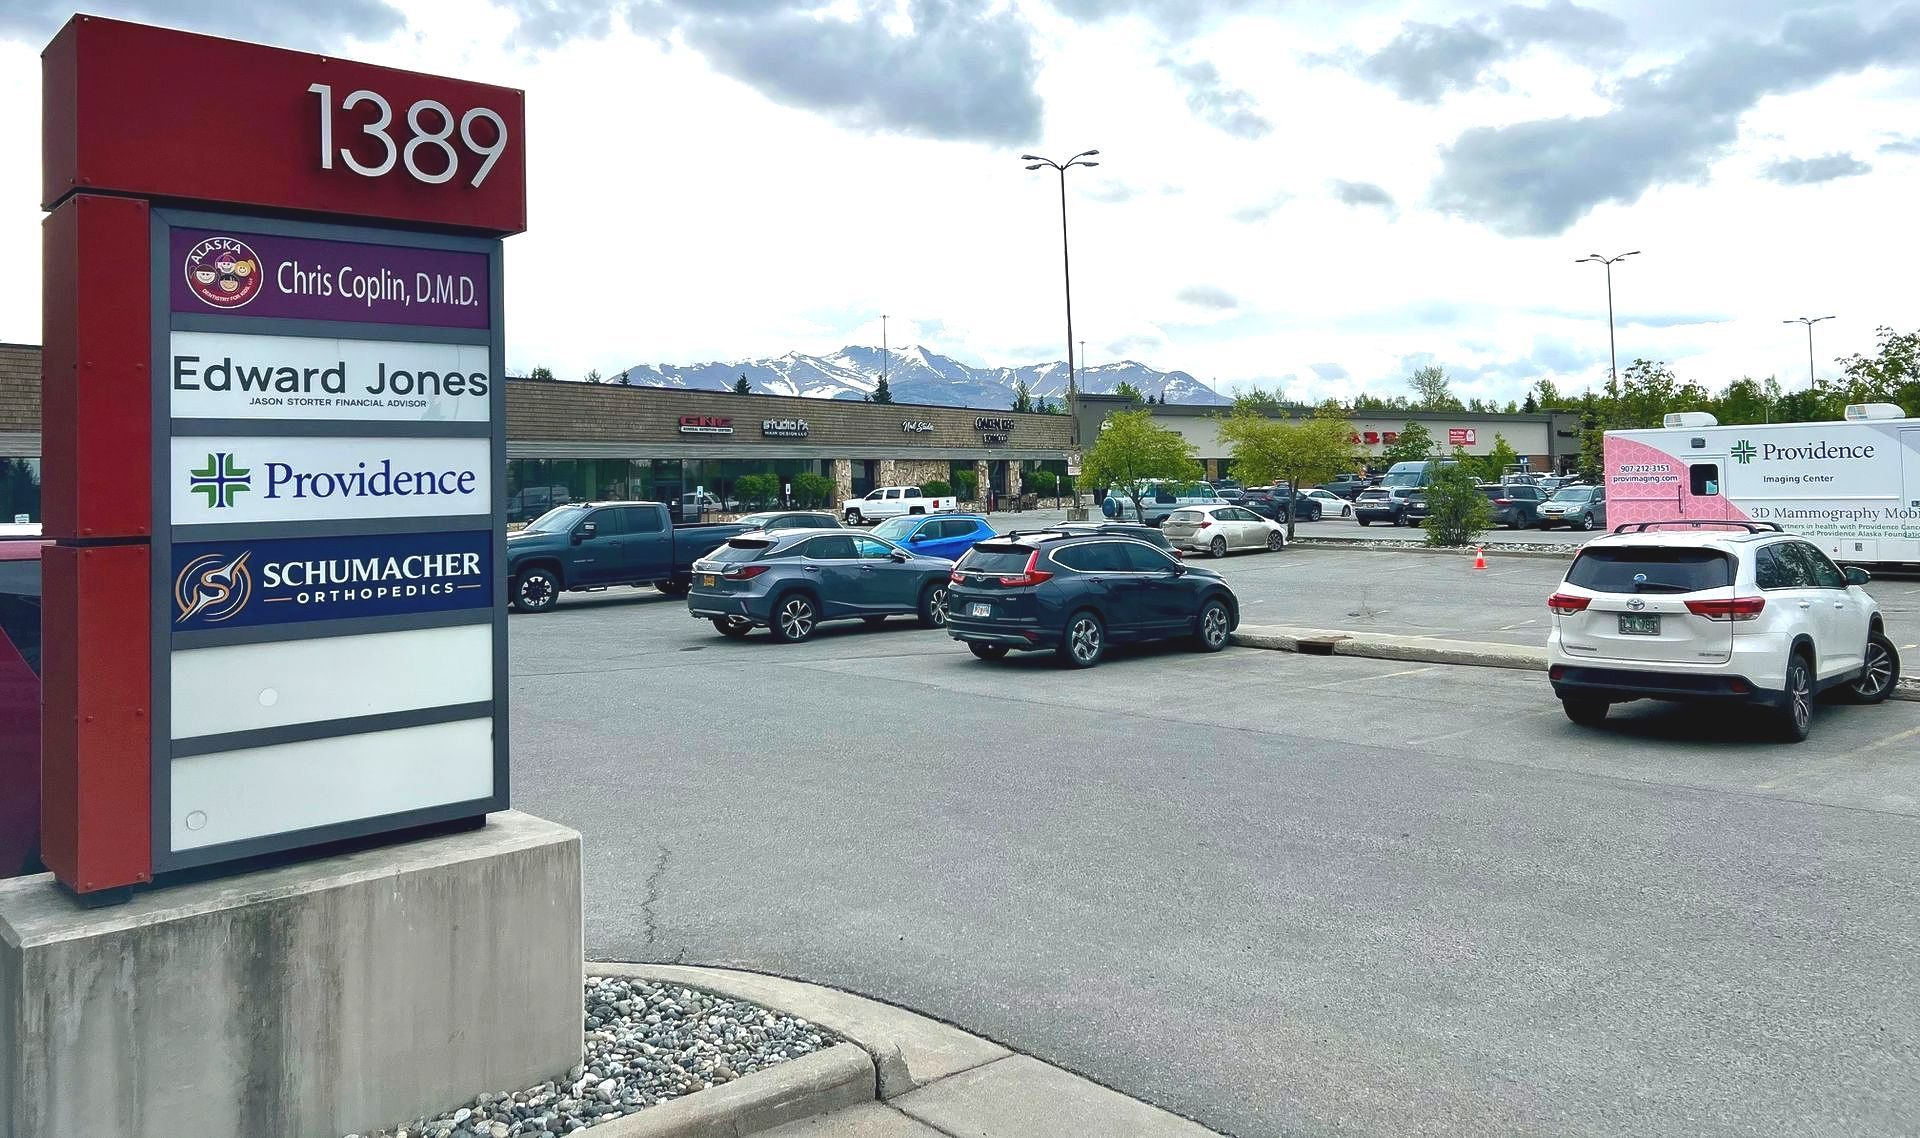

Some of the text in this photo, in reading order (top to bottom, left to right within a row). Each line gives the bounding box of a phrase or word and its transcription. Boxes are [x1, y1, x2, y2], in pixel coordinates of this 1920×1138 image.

[307, 83, 507, 188] 1389
[191, 240, 241, 265] ALASKA
[277, 261, 478, 307] Chris Coplin, D.M.D.
[173, 355, 488, 397] Edward Jones
[249, 397, 427, 408] JASON STORTER FINANCIAL ADVISOR
[1763, 441, 1875, 461] Providence
[263, 459, 476, 499] Providence
[1613, 475, 1678, 483] provimaging.com
[1620, 464, 1670, 472] 907-212-3151
[1763, 474, 1834, 485] Imaging Center
[1751, 508, 1770, 518] 3D
[1774, 507, 1880, 522] Mammography
[263, 552, 481, 588] SCHUMACHER
[296, 582, 455, 604] ORTHOPEDICS
